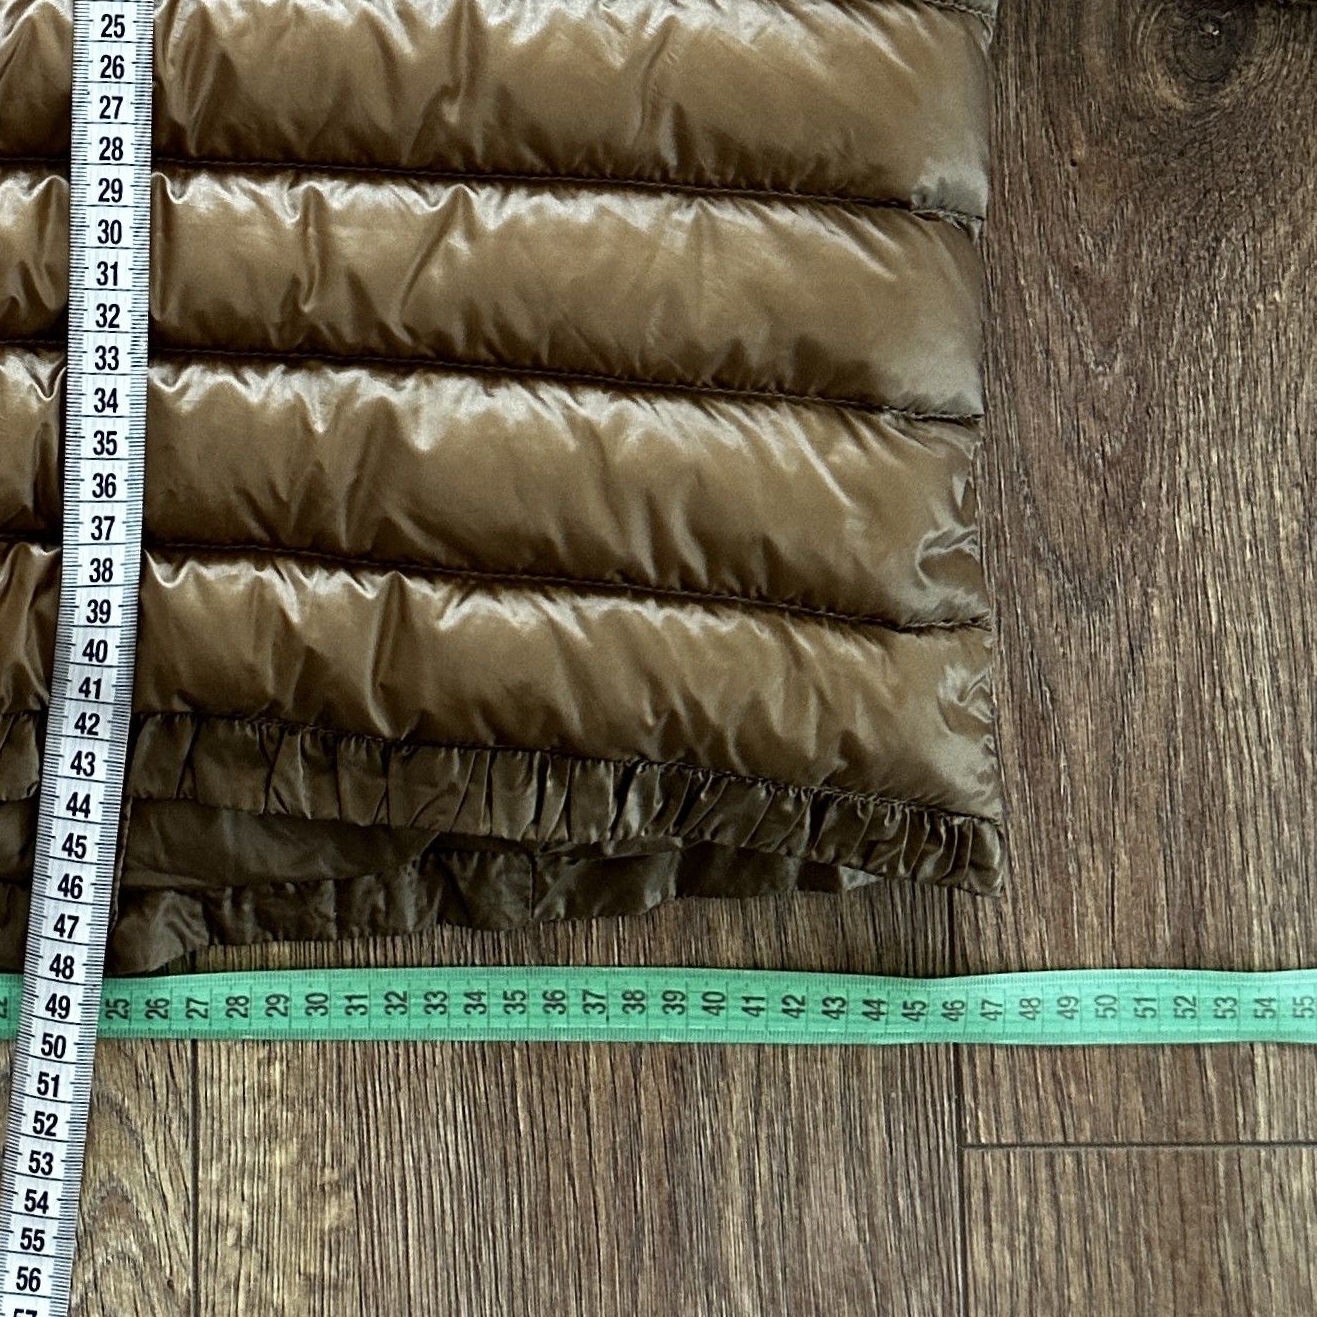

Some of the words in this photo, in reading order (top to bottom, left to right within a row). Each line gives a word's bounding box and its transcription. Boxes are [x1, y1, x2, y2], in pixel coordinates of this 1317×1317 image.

[100, 13, 126, 39] 25
[99, 54, 125, 80] 26
[99, 94, 124, 120] 27
[98, 135, 124, 162] 28
[97, 177, 124, 204] 29
[97, 218, 123, 245] 30
[95, 260, 119, 287] 31
[95, 302, 121, 329] 32
[94, 345, 120, 371] 33
[93, 387, 119, 414] 34
[92, 429, 118, 456] 35
[91, 472, 117, 499] 36
[90, 515, 116, 541] 37
[88, 557, 114, 583] 38
[85, 598, 112, 625] 39
[81, 638, 109, 664] 40
[77, 676, 103, 700] 41
[73, 711, 101, 737] 42
[69, 749, 96, 777] 43
[65, 791, 91, 819] 44
[61, 832, 88, 860] 45
[57, 873, 84, 900] 46
[53, 913, 80, 940] 47
[48, 953, 75, 981] 48
[44, 992, 71, 1020] 49
[103, 997, 132, 1021] 25
[143, 997, 171, 1021] 26
[225, 995, 250, 1019] 28
[304, 992, 330, 1017] 30
[383, 990, 409, 1016] 32
[423, 990, 451, 1016] 33
[501, 989, 530, 1015] 35
[581, 988, 609, 1015] 37
[620, 989, 649, 1015] 38
[661, 989, 689, 1016] 39
[700, 991, 729, 1017] 40
[780, 994, 807, 1020] 42
[821, 996, 849, 1021] 43
[939, 999, 966, 1023] 46
[1251, 997, 1279, 1021] 54
[40, 1031, 67, 1060] 50
[36, 1070, 60, 1098] 51
[32, 1109, 59, 1138] 52
[27, 1149, 54, 1177] 53
[23, 1188, 50, 1215] 54
[19, 1226, 46, 1253] 55
[15, 1265, 42, 1293] 56
